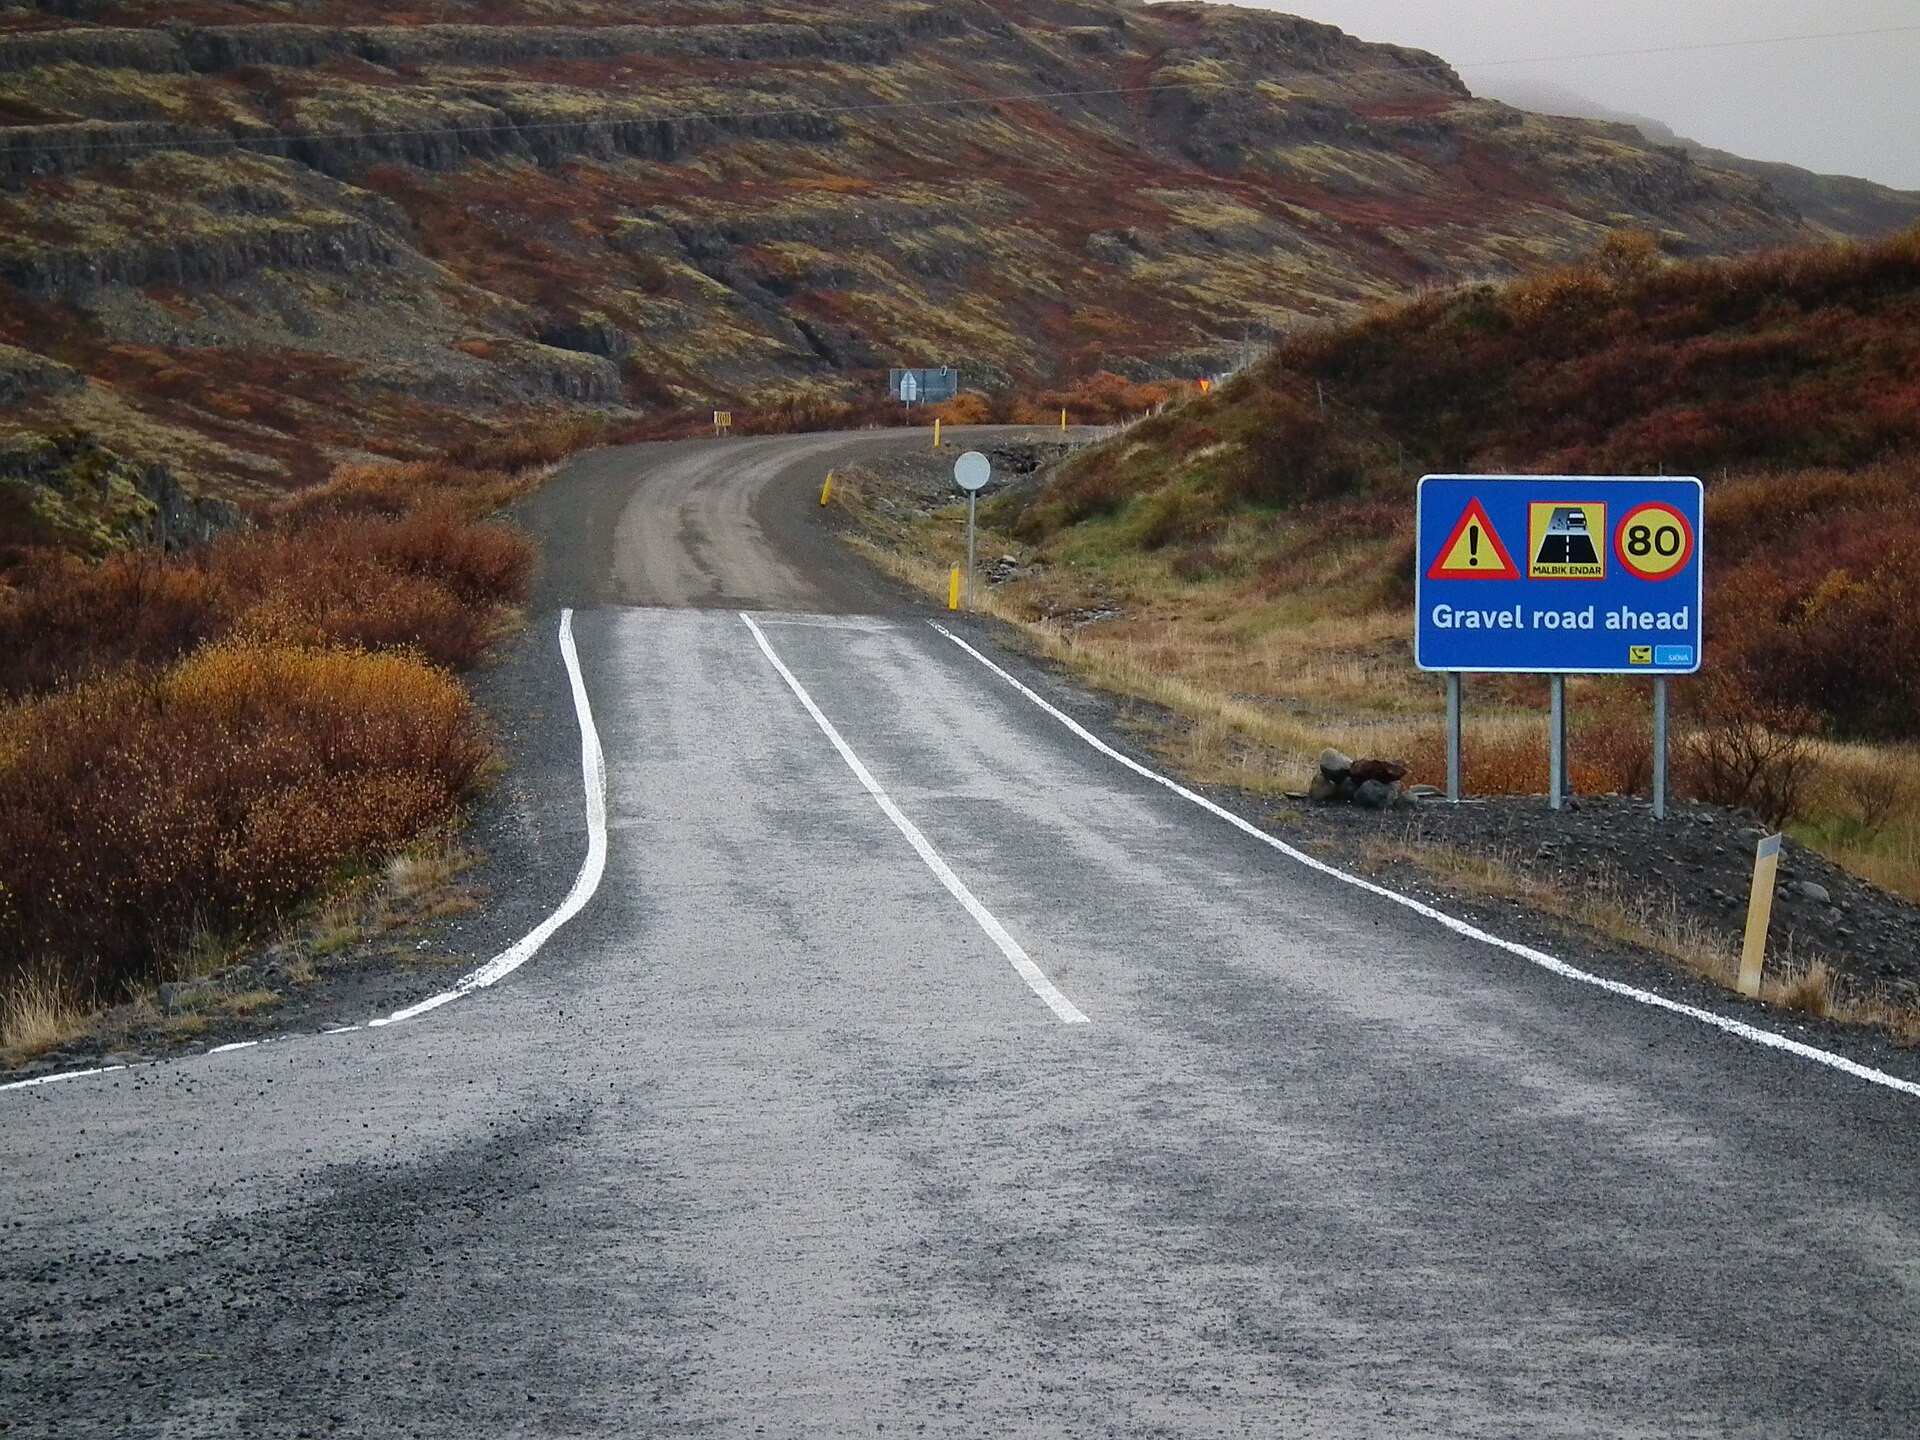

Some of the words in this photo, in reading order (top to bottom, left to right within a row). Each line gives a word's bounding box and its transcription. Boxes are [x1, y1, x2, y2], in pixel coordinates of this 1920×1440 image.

[1627, 525, 1681, 557] 80
[1533, 566, 1567, 575] MALBIK
[1569, 566, 1602, 575] ENDAR
[1431, 603, 1524, 630] Gravel
[1533, 605, 1594, 630] road
[1605, 605, 1689, 631] ahead
